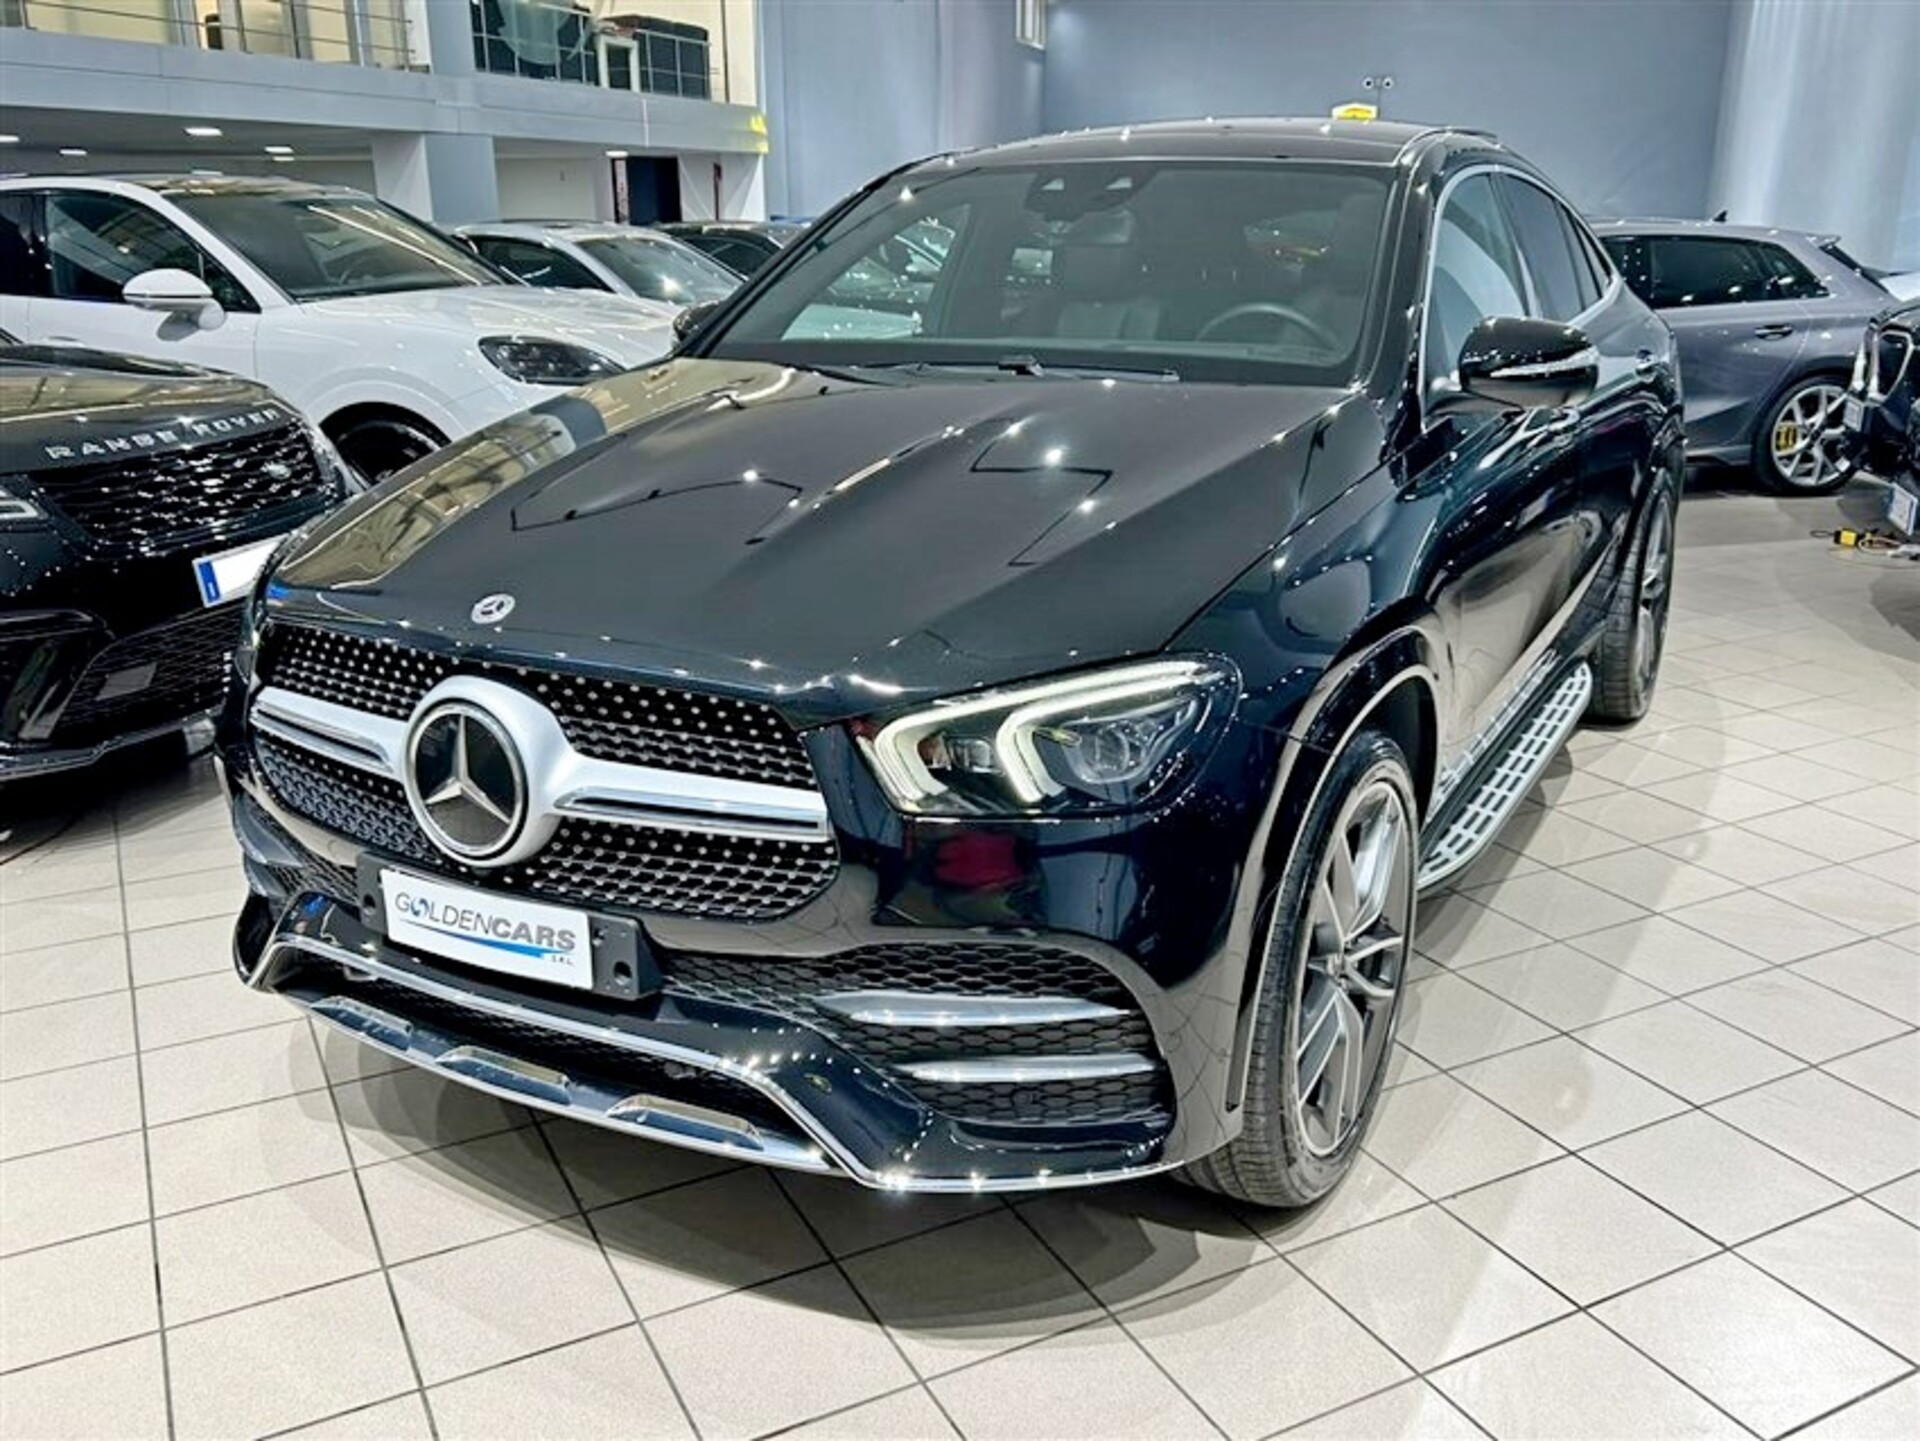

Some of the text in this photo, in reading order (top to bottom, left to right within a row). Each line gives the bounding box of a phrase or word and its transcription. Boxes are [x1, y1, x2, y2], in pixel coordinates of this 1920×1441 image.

[45, 408, 280, 459] RANGE ROVER
[395, 892, 576, 951] GOLDENCARS
